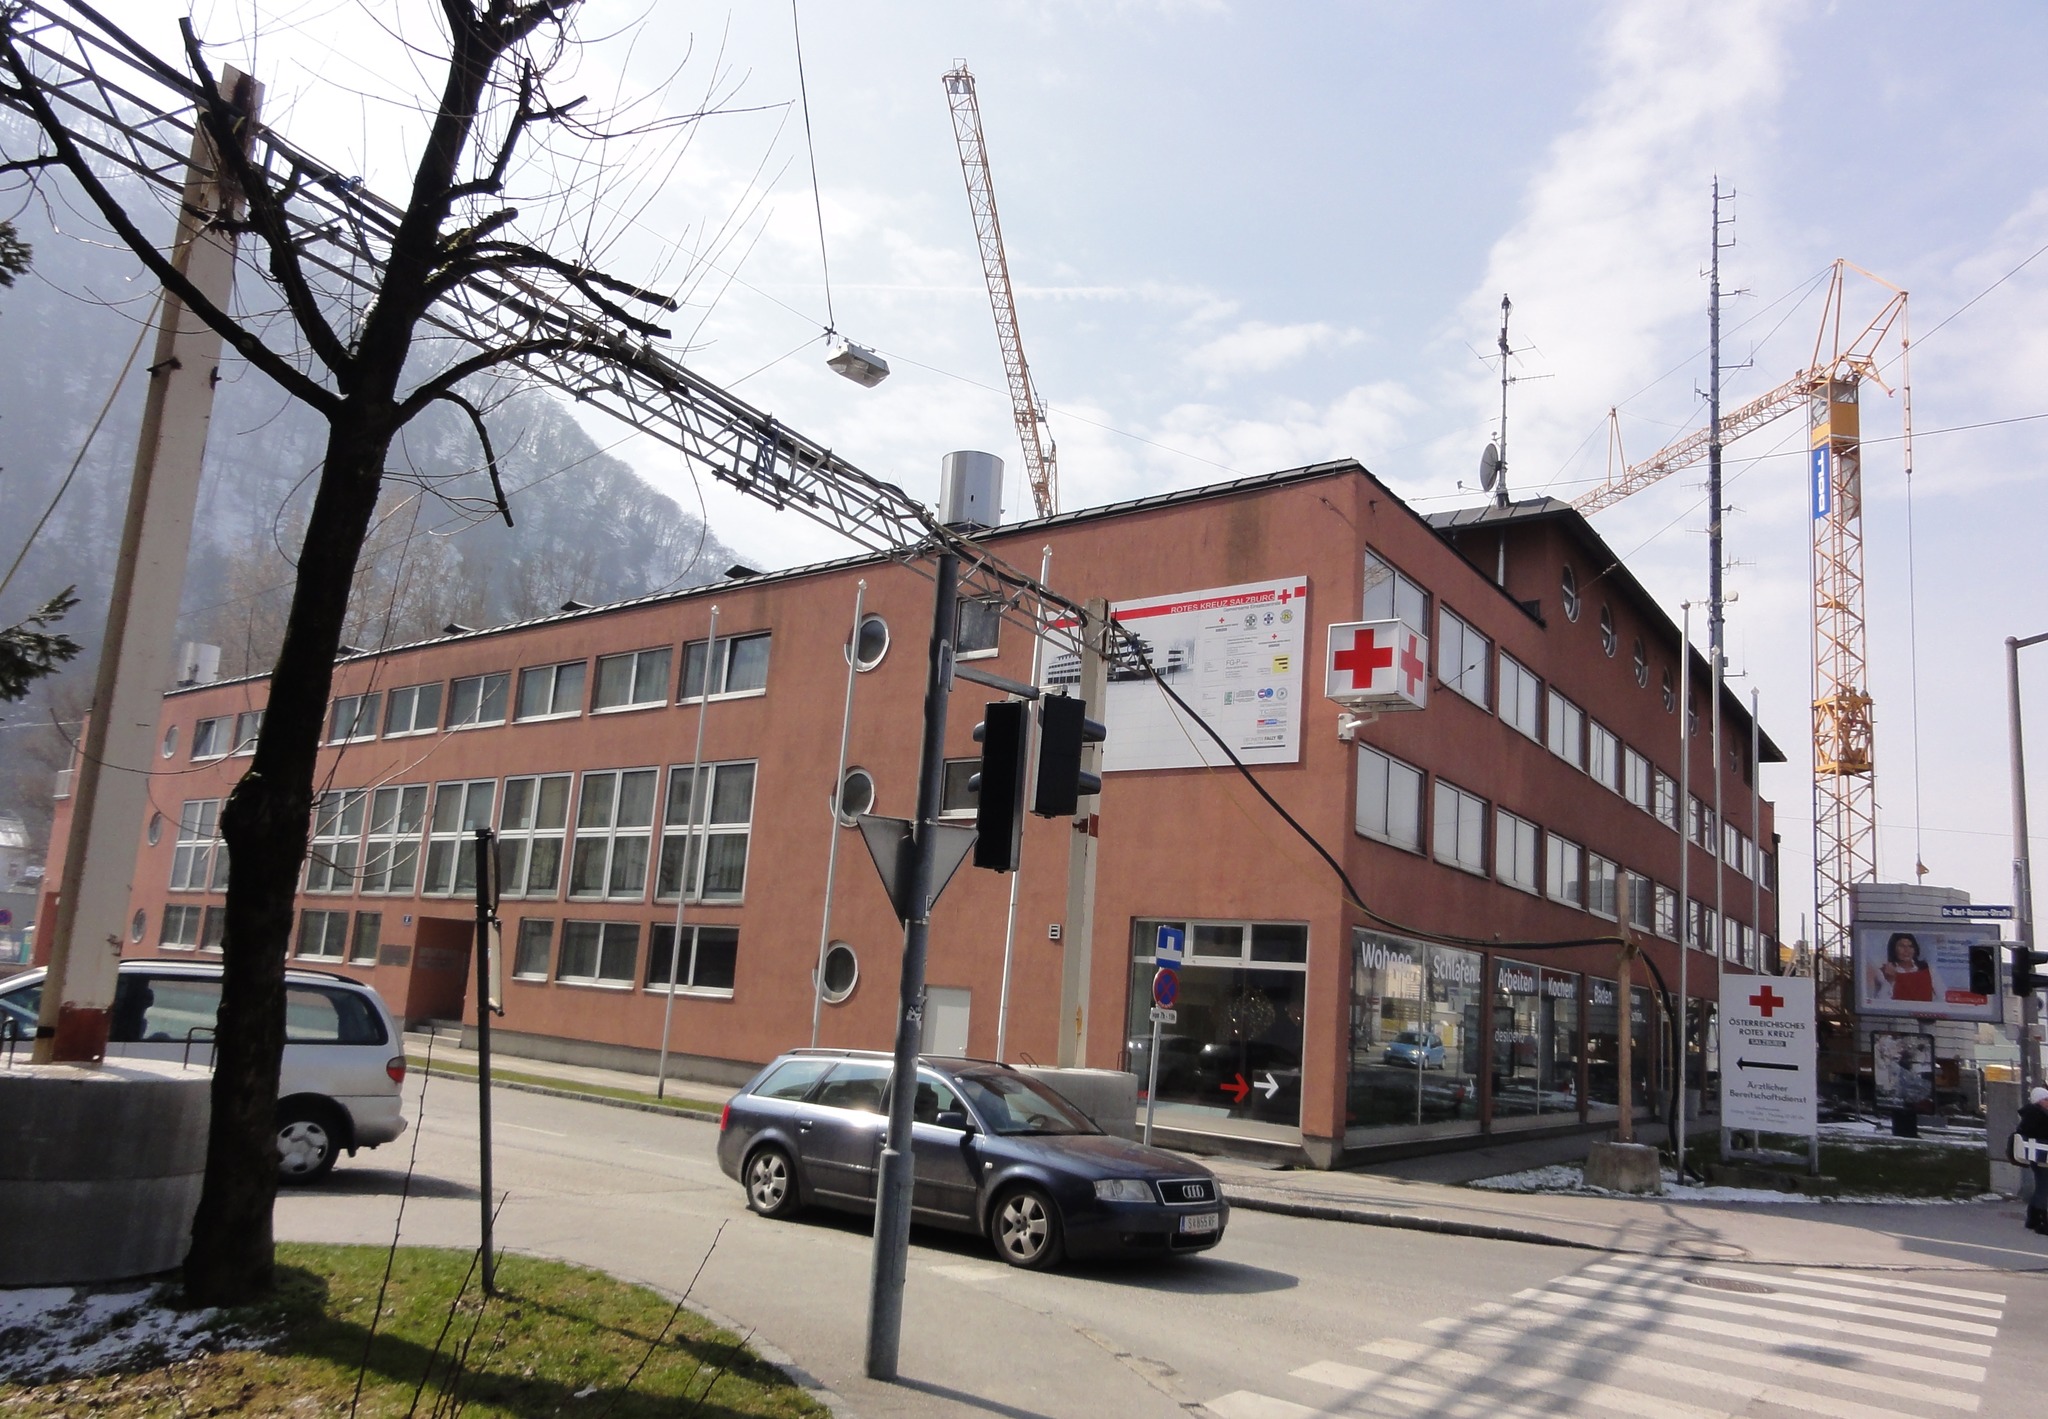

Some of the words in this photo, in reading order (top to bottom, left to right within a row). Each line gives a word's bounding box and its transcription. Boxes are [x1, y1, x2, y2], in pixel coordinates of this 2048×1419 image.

[1170, 605, 1199, 614] ROTES
[1200, 600, 1228, 610] KREUZ
[1229, 594, 1275, 606] SALZBURG
[1433, 955, 1476, 984] Schlafen
[1498, 967, 1533, 993] Arbeiten
[1547, 977, 1573, 999] Kochen
[1594, 985, 1612, 1005] Baden
[1729, 1017, 1805, 1029] ÖSTERREICHISCHES
[1739, 1028, 1764, 1036] ROTES
[1767, 1030, 1795, 1038] KREUZ
[1747, 1080, 1788, 1092] Ärztlicher
[1729, 1089, 1807, 1104] Bereitschaftsdienst
